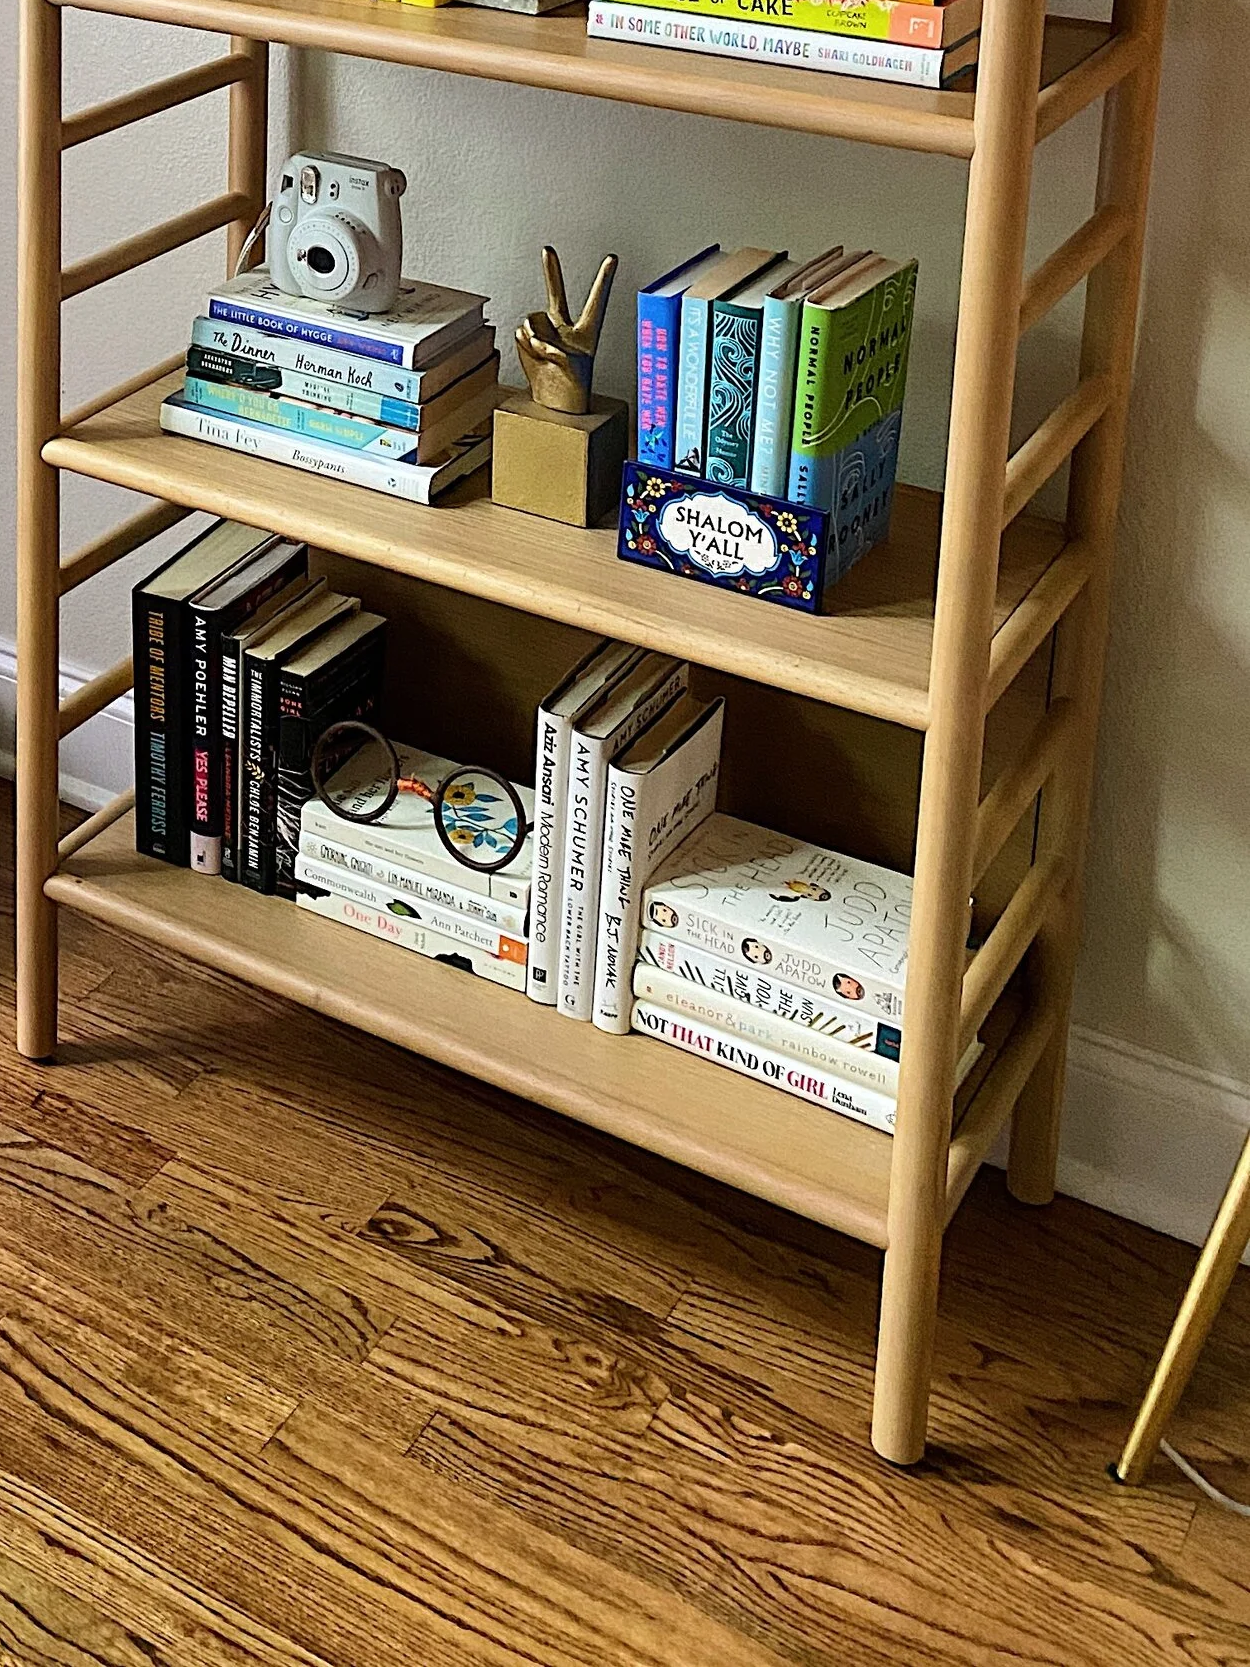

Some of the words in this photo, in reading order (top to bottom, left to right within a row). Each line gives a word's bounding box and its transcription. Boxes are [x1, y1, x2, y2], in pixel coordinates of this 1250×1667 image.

[609, 13, 624, 29] IN
[628, 16, 661, 36] SOME
[664, 22, 705, 43] OTHER
[709, 29, 761, 52] WORLD,
[762, 37, 811, 59] MAYBE
[817, 46, 849, 61] SHARI
[852, 52, 913, 72] GOLDHAGEN
[212, 304, 228, 317] THE
[229, 309, 256, 324] LITTLE
[258, 316, 285, 331] BOOK
[286, 322, 299, 333] OF
[301, 326, 333, 344] HYGGE
[766, 316, 783, 361] WHY
[843, 315, 906, 375] NORMAL
[213, 331, 228, 348] The
[230, 332, 276, 363] Dinner
[295, 353, 343, 380] Herman
[347, 365, 373, 388] Koch
[806, 325, 821, 386] NORMAL
[763, 369, 779, 411] NOT
[845, 353, 902, 411] PEOPLE
[196, 416, 229, 441] Tina
[235, 428, 261, 452] Fey
[801, 393, 815, 445] PEOPLE
[291, 448, 347, 475] Bossypants
[675, 506, 763, 544] SHALOM
[689, 529, 744, 561] Y'ALL
[148, 610, 165, 646] TRIBE
[194, 615, 207, 654] AMY
[148, 647, 165, 664] OF
[222, 655, 237, 684] MAN
[250, 668, 263, 680] THE
[149, 664, 165, 722] MENTORS
[195, 659, 207, 736] POEHLER
[221, 683, 237, 740] REPELLER
[612, 727, 635, 754] AMY
[636, 675, 681, 729] SCHUMER
[249, 678, 263, 762] IMMORTALISTS
[543, 721, 558, 754] Aziz
[149, 731, 166, 785] TIMOTHY
[195, 751, 209, 774] YES
[576, 742, 591, 789] AMY
[195, 777, 208, 823] PLEASE
[249, 780, 261, 814] CHLOE
[541, 754, 556, 807] Ansari
[151, 786, 166, 836] FERRISS
[620, 785, 637, 821] ONE
[248, 815, 260, 869] BENJAMIN
[539, 811, 554, 872] Modern
[570, 794, 588, 892] SCHUMER
[304, 868, 377, 904] Commonwealth
[430, 916, 453, 932] Ann
[453, 923, 494, 948] Patchett
[342, 902, 373, 925] One
[376, 915, 404, 939] Day
[535, 872, 552, 943] Romance
[685, 913, 718, 936] SICK
[722, 929, 734, 941] IN
[824, 881, 887, 942] JUDD
[687, 929, 702, 940] THE
[704, 934, 735, 954] HEAD
[605, 944, 619, 989] NOVAK
[733, 969, 749, 1000] GIVE
[774, 962, 827, 989] APATOW
[781, 953, 822, 975] JUDD
[754, 977, 772, 1005] YOU
[778, 989, 794, 1014] THE
[800, 997, 815, 1024] SUN
[635, 1008, 669, 1034] NOT
[670, 1022, 715, 1053] THAT
[716, 1040, 760, 1071] KIND
[762, 1060, 786, 1081] OF
[787, 1070, 829, 1100] GIRL
[782, 1038, 839, 1067] rainbow
[843, 1061, 886, 1085] rowell
[831, 1095, 868, 1116] Dunham
[832, 1086, 853, 1102] Lena
